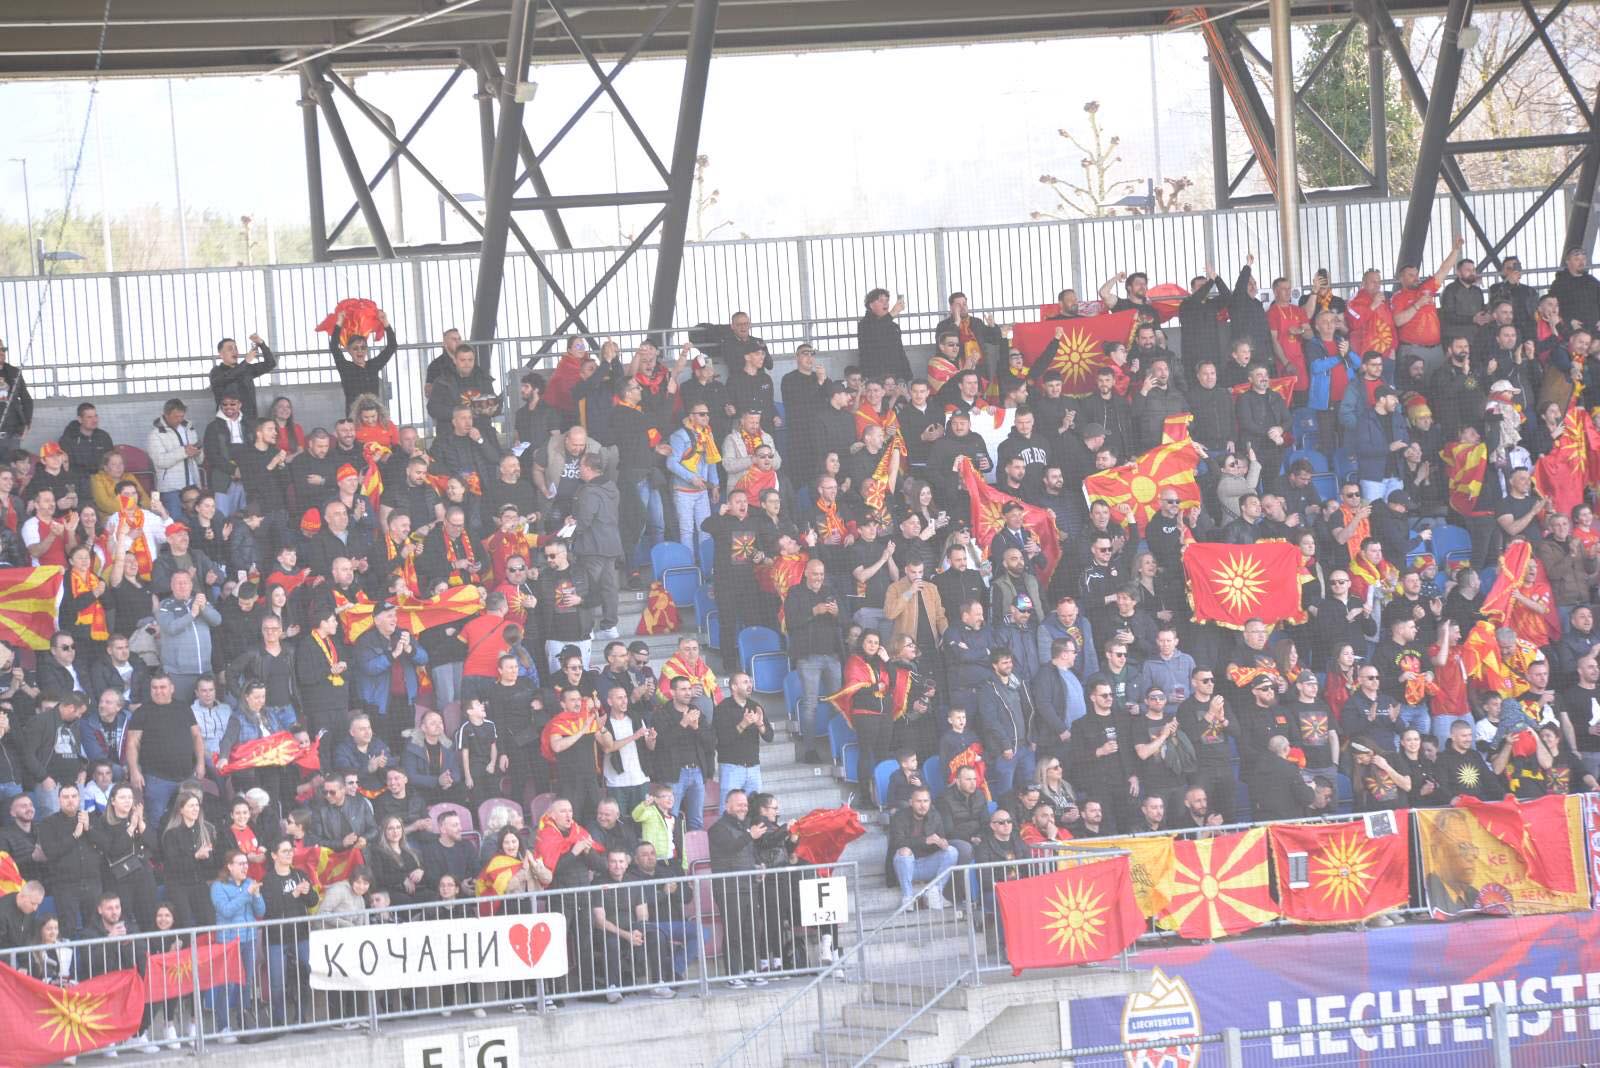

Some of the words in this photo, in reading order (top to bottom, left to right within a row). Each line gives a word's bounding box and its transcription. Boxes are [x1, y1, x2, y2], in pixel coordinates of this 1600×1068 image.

[817, 882, 830, 908] F
[812, 911, 837, 922] 1-21
[324, 930, 499, 978] КОЧАНИ
[1131, 1016, 1190, 1030] LIECHTENSTEIN
[477, 1039, 508, 1068] G
